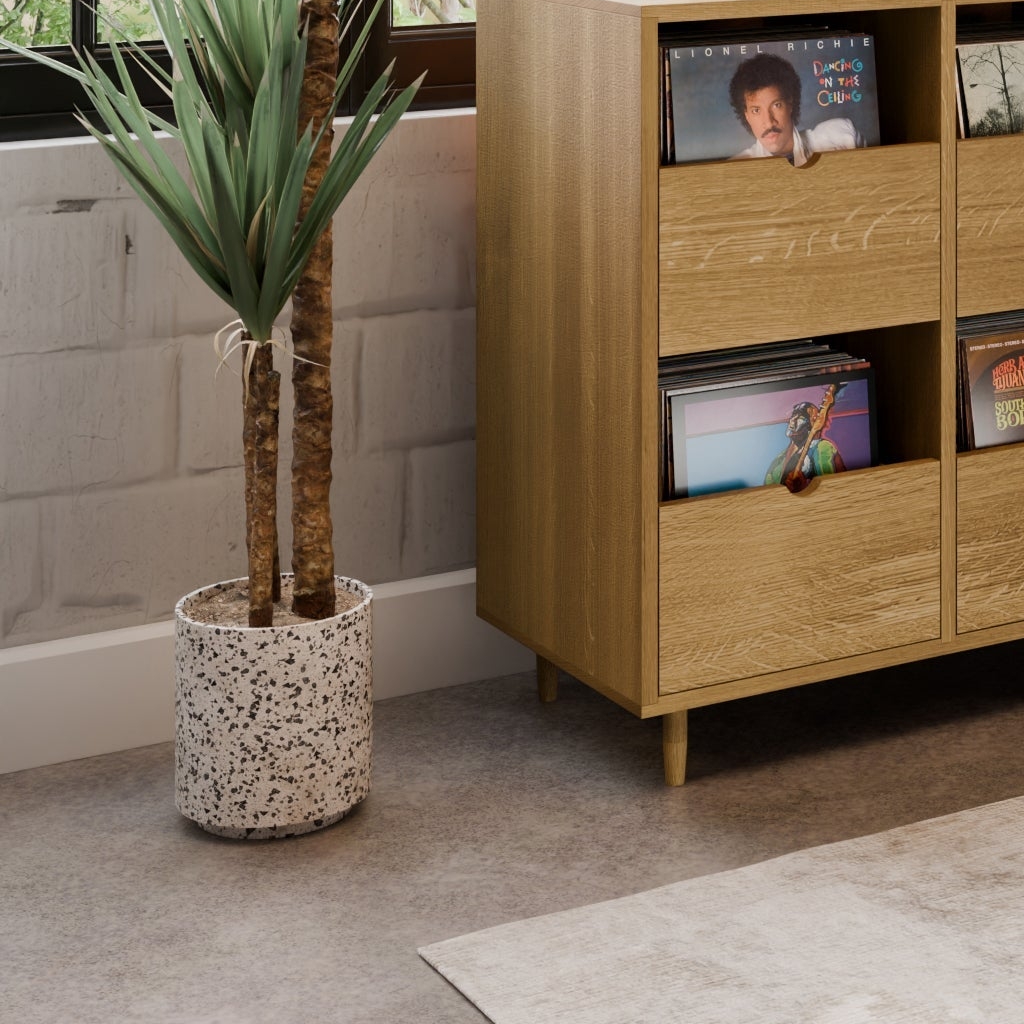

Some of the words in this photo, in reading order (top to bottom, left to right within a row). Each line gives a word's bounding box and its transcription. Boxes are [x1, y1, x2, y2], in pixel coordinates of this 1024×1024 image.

[674, 45, 764, 59] LIONEL
[787, 37, 871, 52] RICHIE
[813, 58, 863, 76] DANCING
[817, 89, 862, 106] CEILING
[992, 358, 1017, 379] HERB
